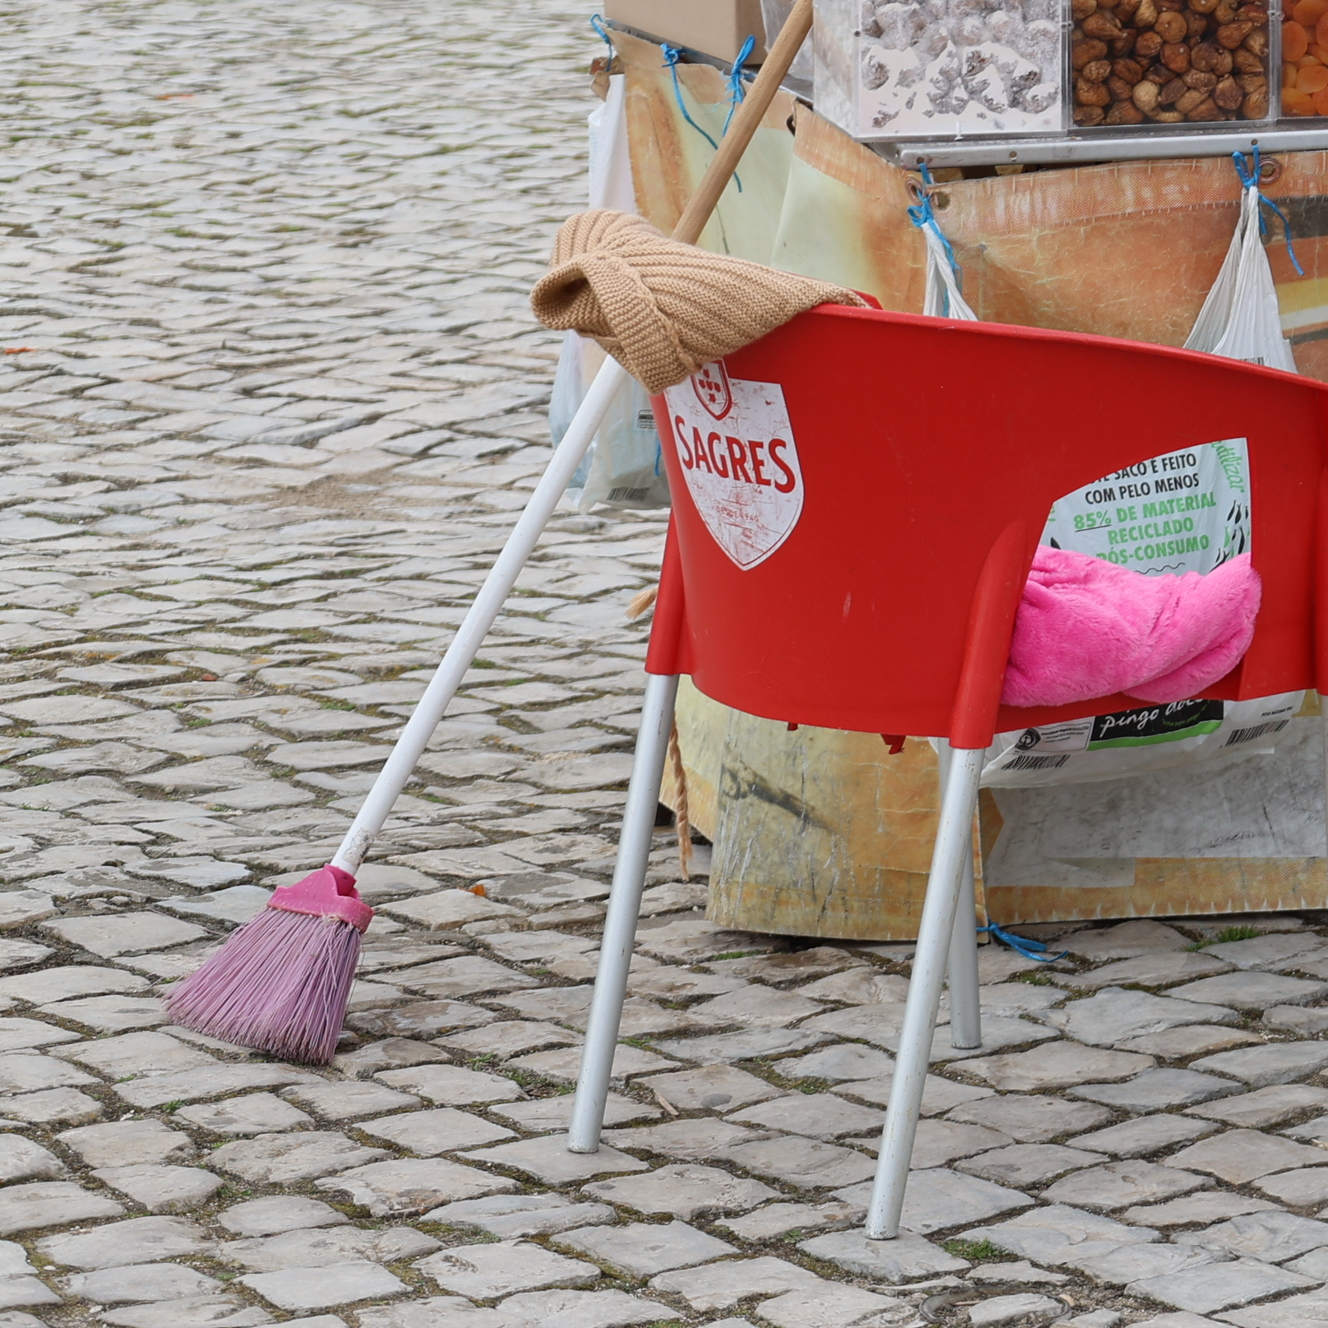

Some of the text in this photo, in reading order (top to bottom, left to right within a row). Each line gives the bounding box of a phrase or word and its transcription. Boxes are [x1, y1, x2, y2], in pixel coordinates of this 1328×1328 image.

[674, 414, 797, 495] SAGRES
[1162, 453, 1197, 473] FEITO
[1085, 472, 1200, 505] COM PELO MENOS
[1073, 490, 1217, 531] 85% DE MATERIAL
[1107, 517, 1195, 546] RECICLADO
[1099, 708, 1159, 738] pingo
